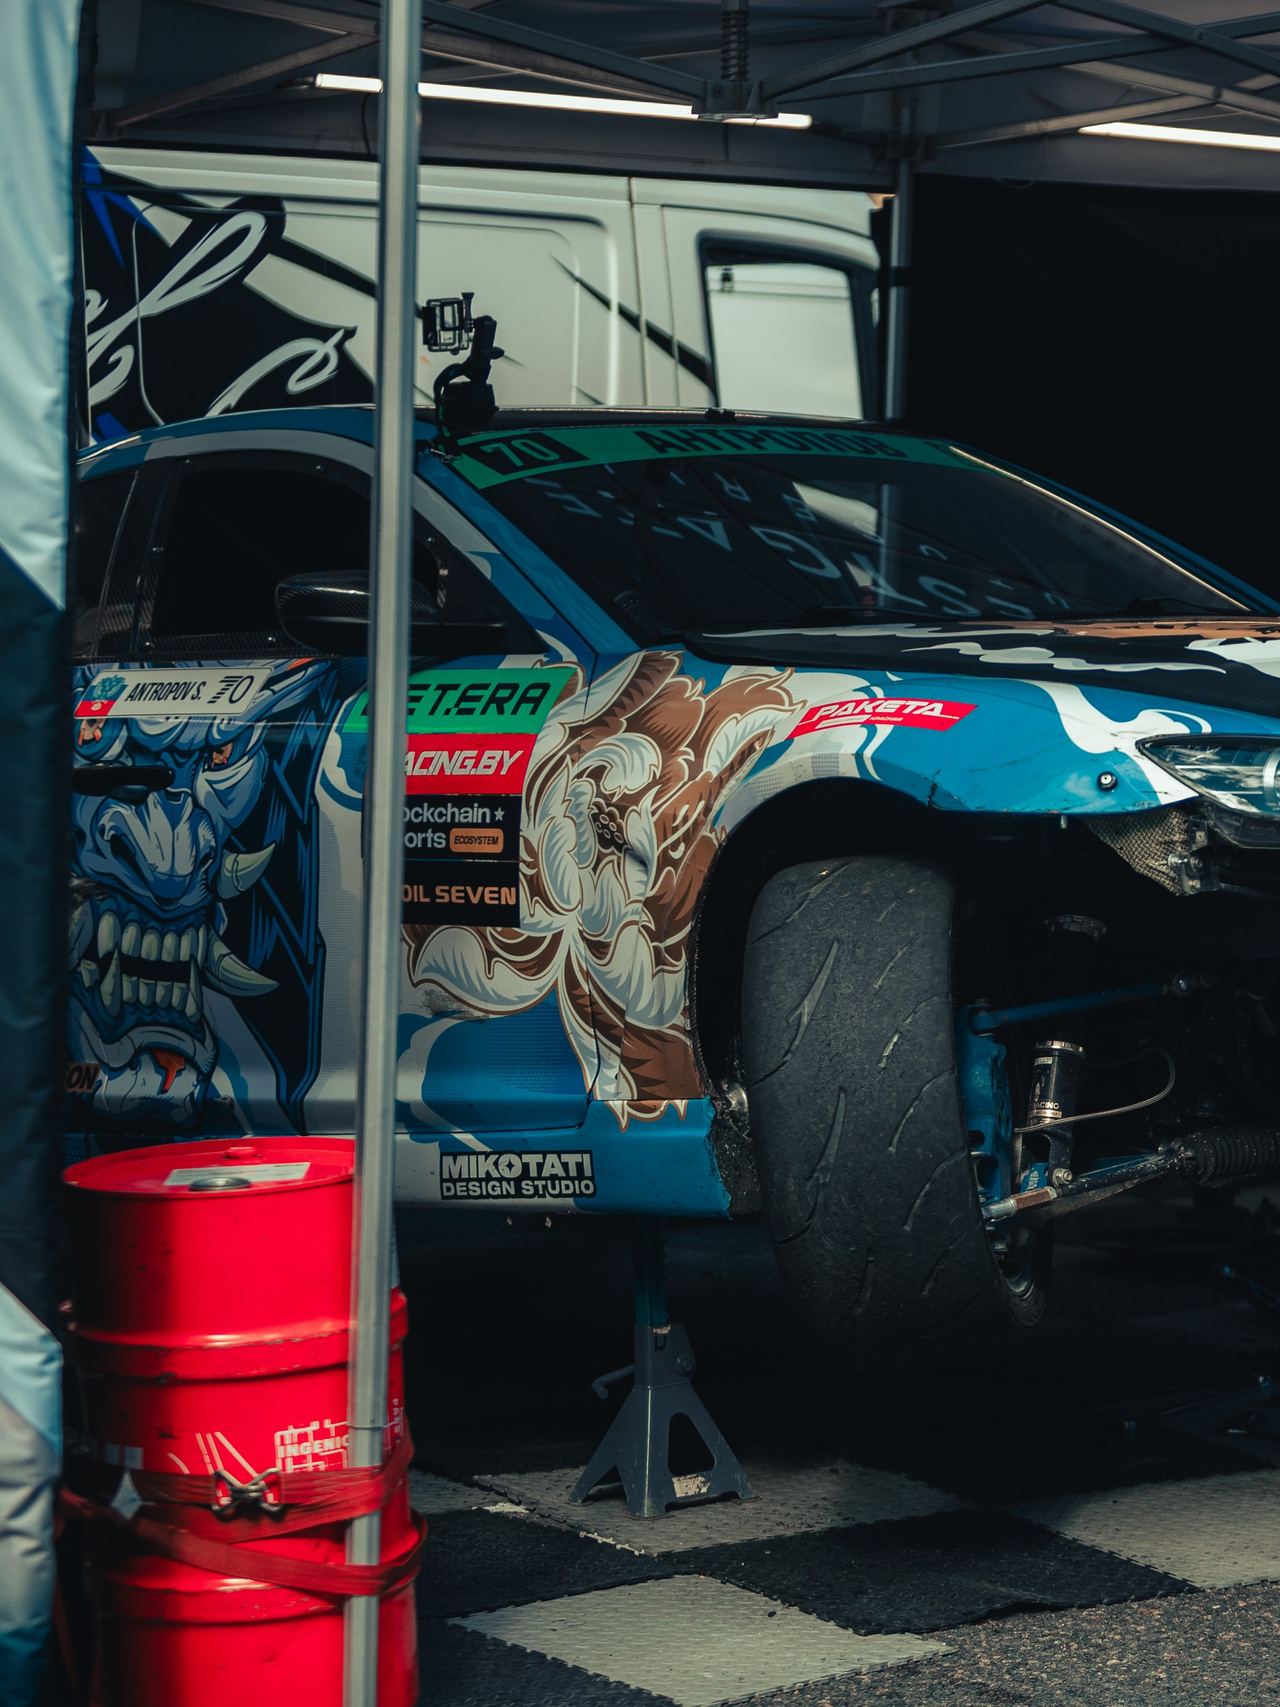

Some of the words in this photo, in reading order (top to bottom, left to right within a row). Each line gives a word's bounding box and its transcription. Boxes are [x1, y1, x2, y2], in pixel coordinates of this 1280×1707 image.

[478, 436, 562, 476] 70
[124, 681, 195, 702] ANTROPOV
[207, 675, 255, 704] 70
[403, 750, 524, 776] ACING.BY
[454, 835, 500, 845] ECOSYSTEM
[435, 885, 517, 905] SEVEN
[442, 1153, 593, 1179] MIKOTATI
[442, 1180, 516, 1197] DESIGN
[521, 1179, 595, 1196] STUDIO
